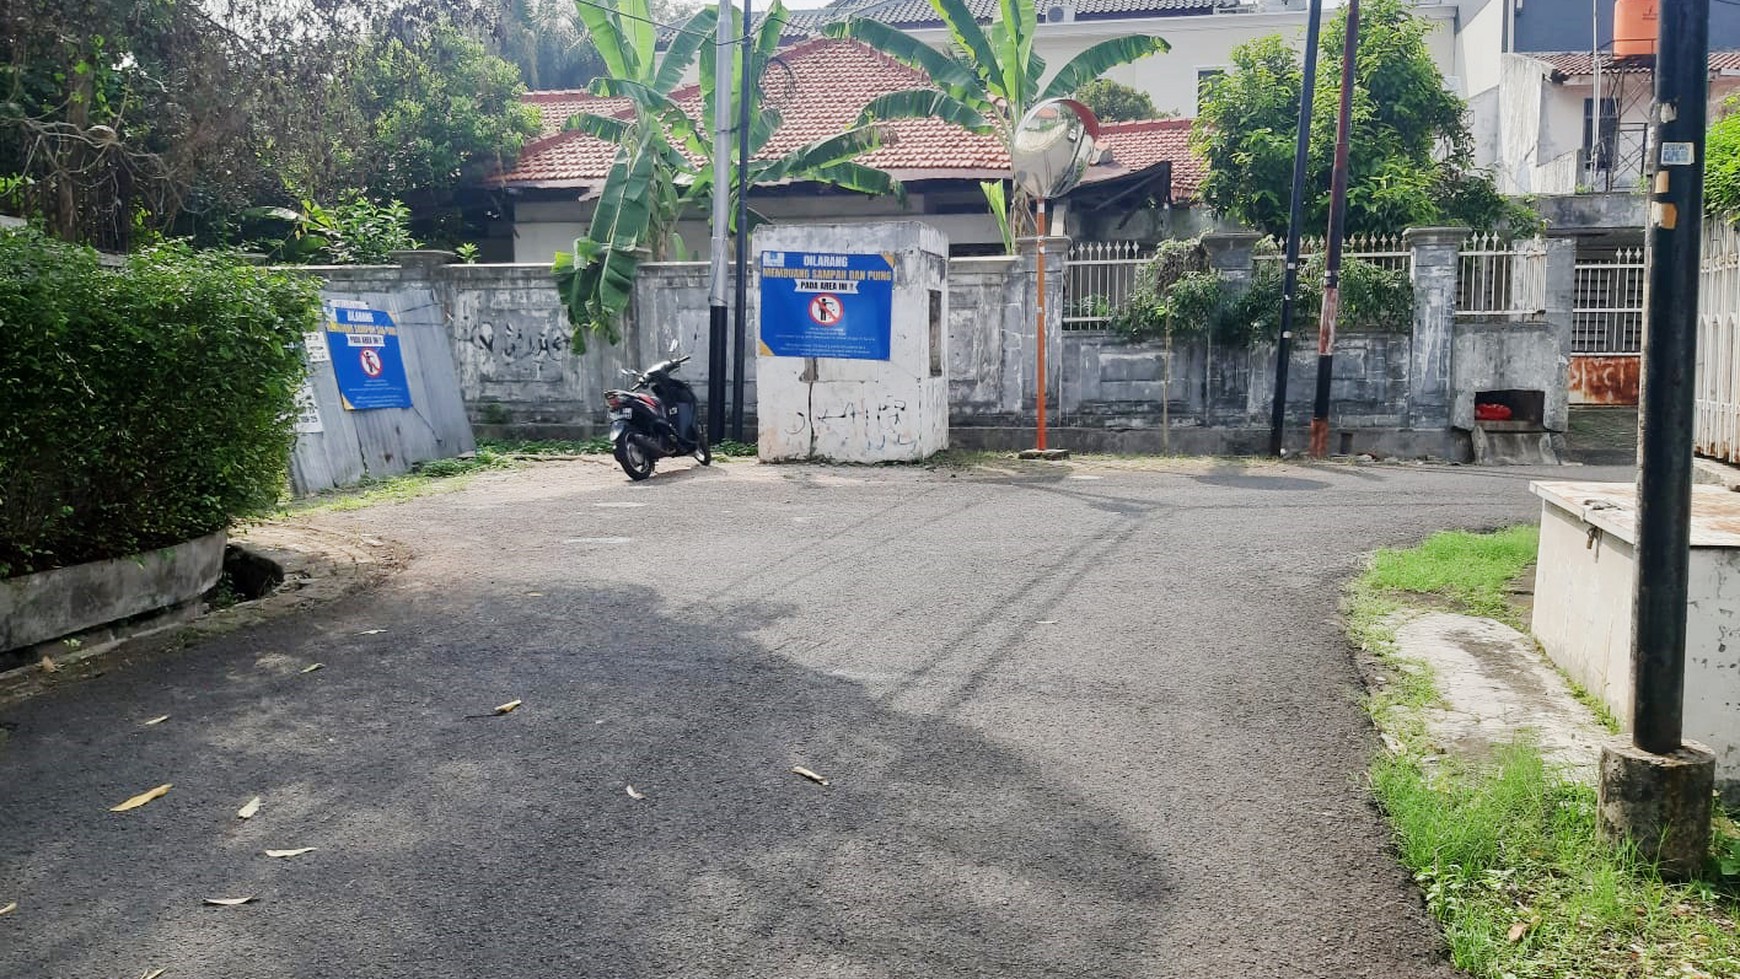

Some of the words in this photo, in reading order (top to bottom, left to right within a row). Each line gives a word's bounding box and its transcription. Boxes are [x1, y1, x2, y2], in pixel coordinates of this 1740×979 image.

[804, 255, 848, 267] DILARANG
[763, 268, 809, 279] MEMBUANG
[811, 269, 847, 280] SAMPAH
[848, 270, 865, 281] DAN
[867, 271, 892, 281] PUING
[800, 281, 818, 289] PADA
[820, 282, 837, 290] AREA
